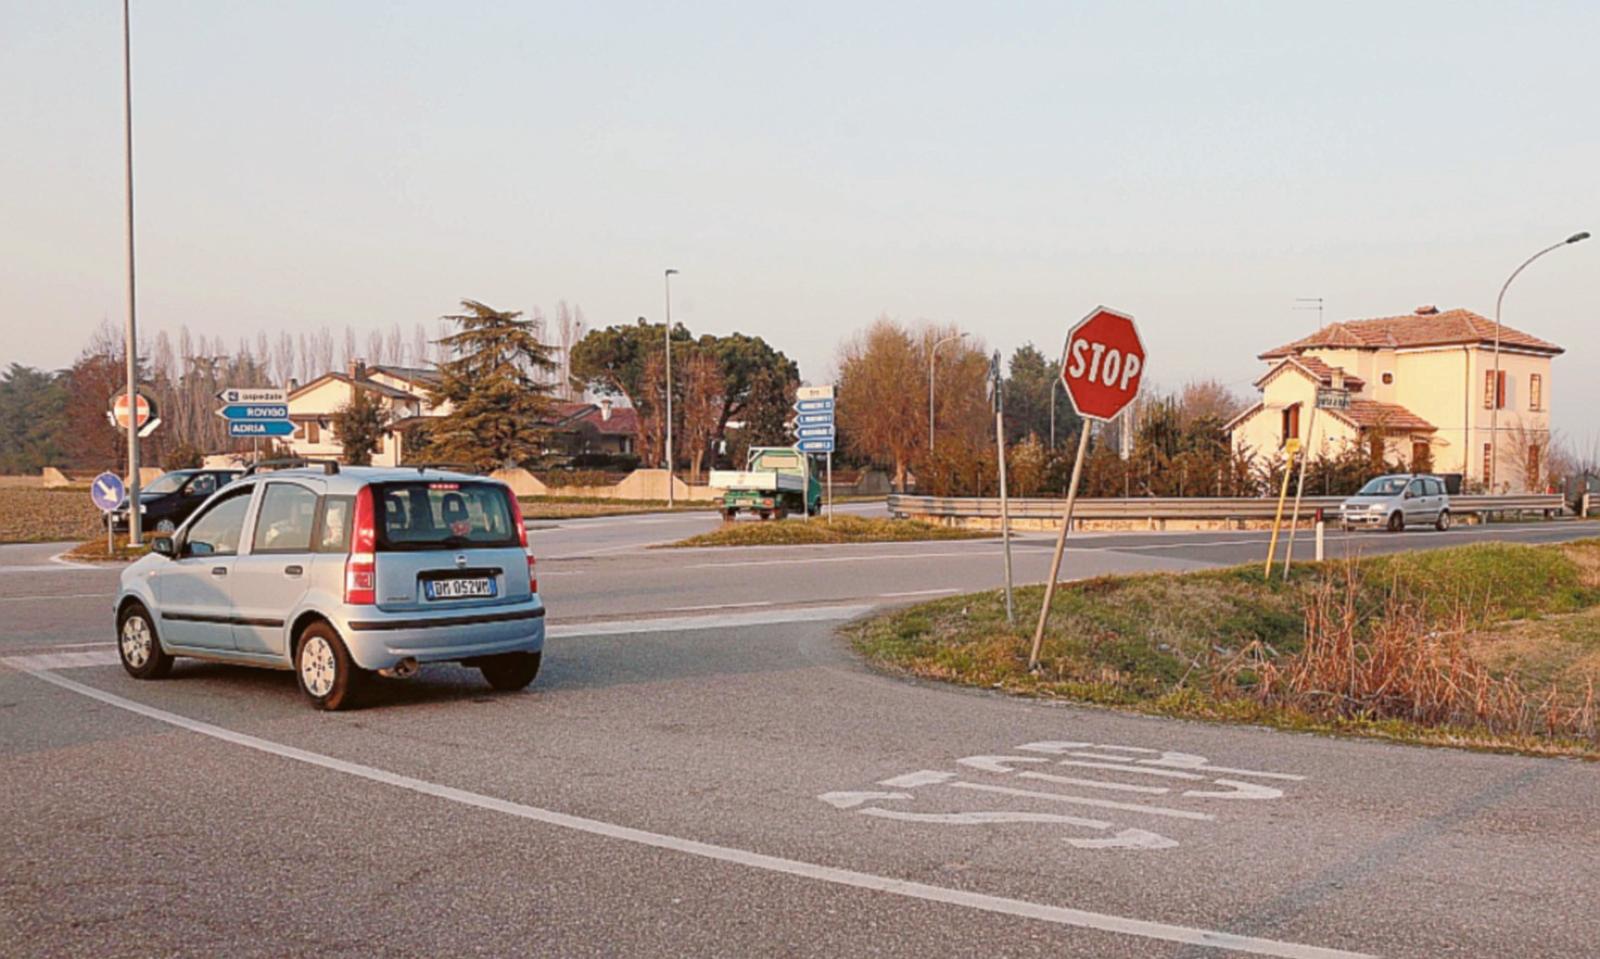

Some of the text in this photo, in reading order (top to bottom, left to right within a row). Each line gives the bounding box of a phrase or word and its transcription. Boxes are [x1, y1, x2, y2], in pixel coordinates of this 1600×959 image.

[1068, 338, 1141, 391] STOP
[247, 408, 286, 417] ROVIGO
[232, 424, 266, 433] ADRIA
[817, 741, 1305, 849] STOP
